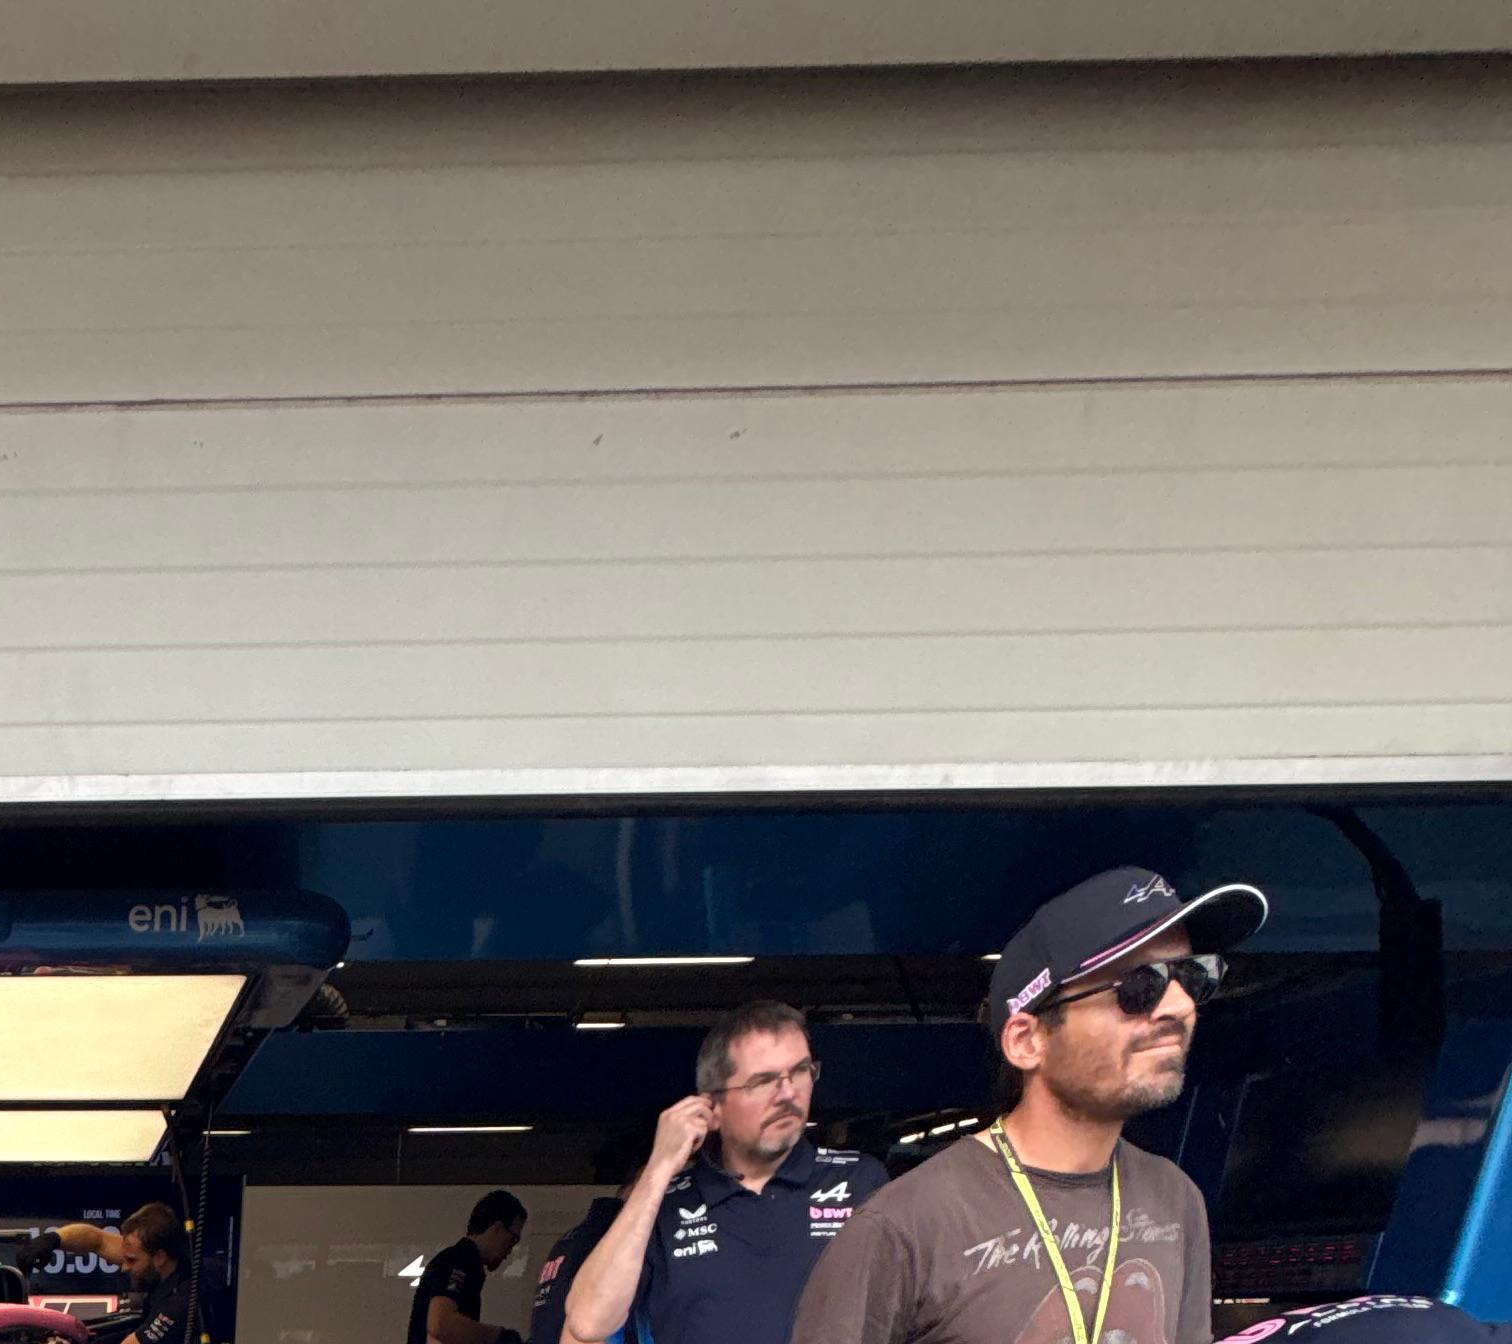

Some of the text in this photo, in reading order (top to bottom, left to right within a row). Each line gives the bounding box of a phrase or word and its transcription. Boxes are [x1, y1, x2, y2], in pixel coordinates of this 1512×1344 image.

[128, 896, 188, 932] eni
[687, 1222, 719, 1238] MSC
[673, 1241, 697, 1258] eni
